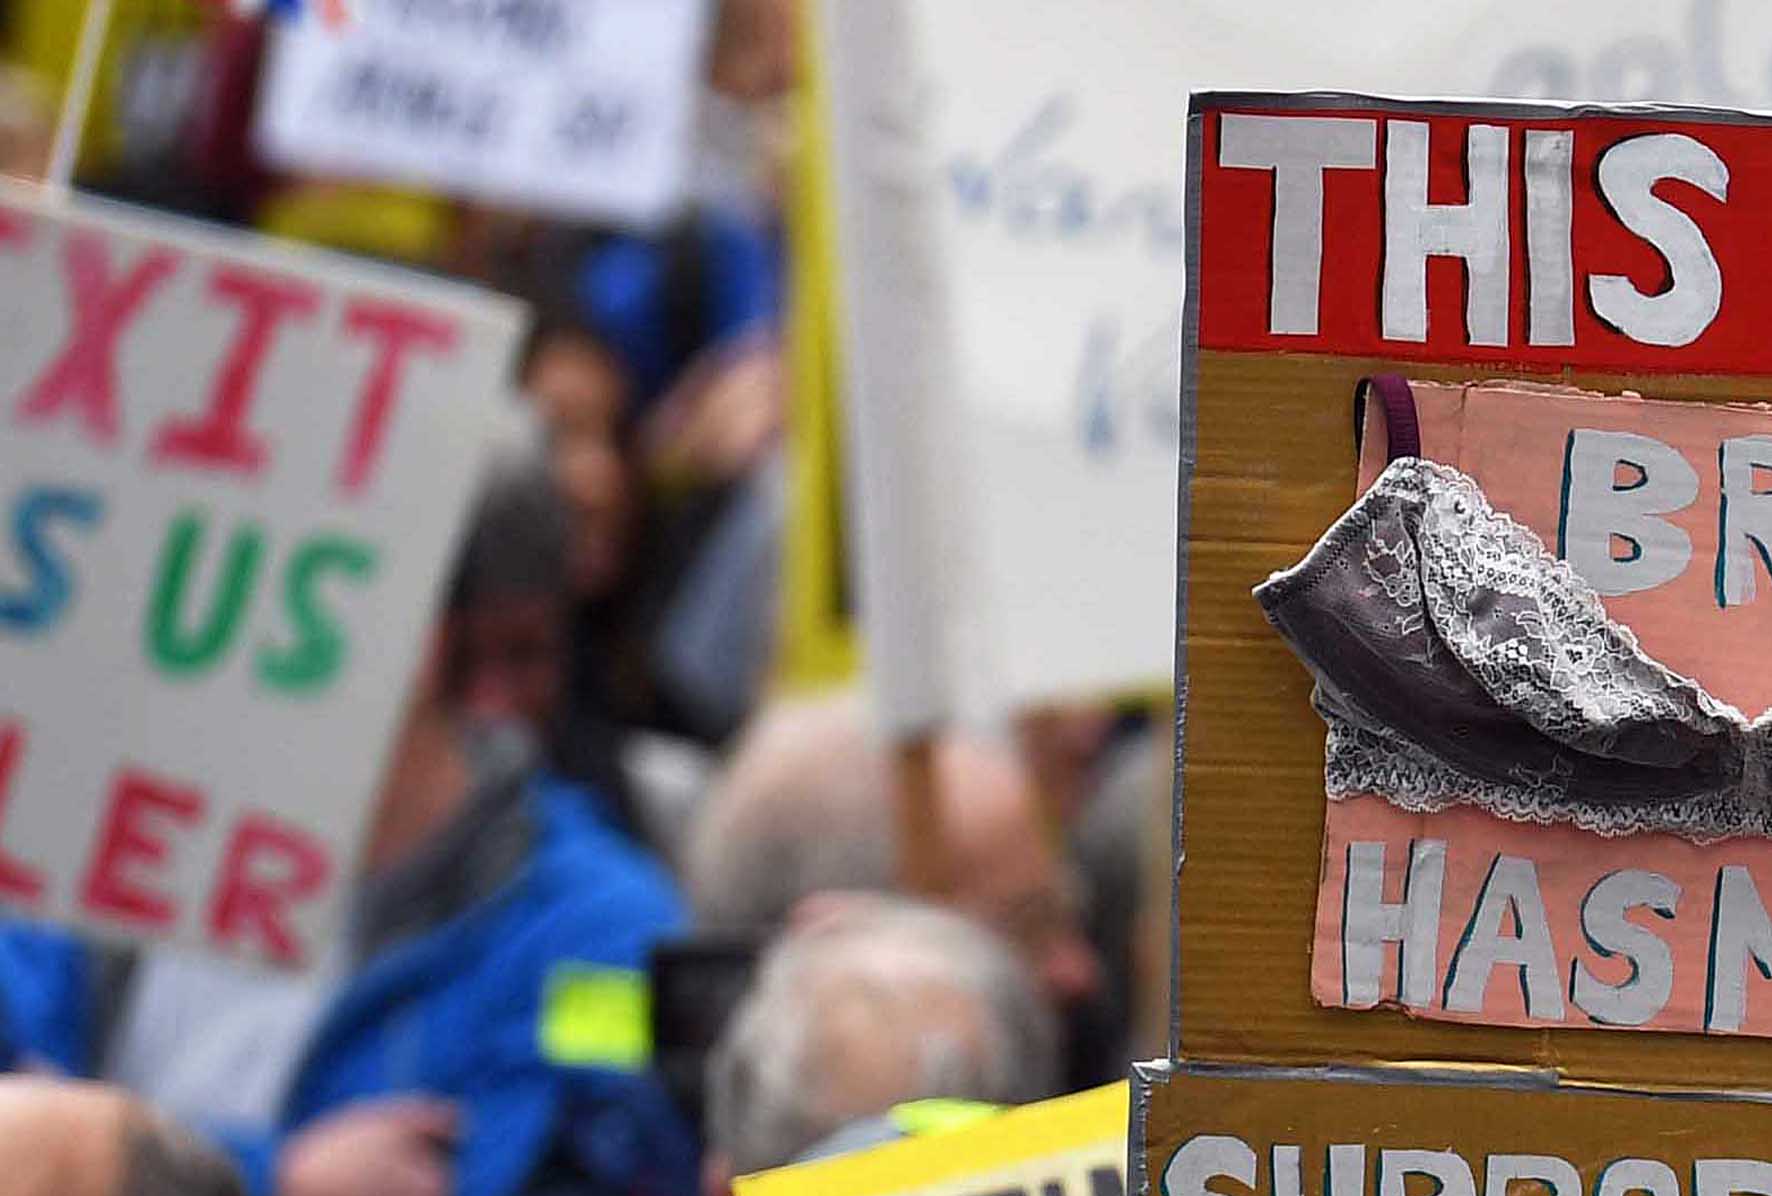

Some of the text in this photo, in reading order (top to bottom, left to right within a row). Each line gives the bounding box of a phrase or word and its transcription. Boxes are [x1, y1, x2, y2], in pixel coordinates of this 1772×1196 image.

[1218, 112, 1730, 348] THIS
[0, 205, 460, 502] XIT
[143, 508, 382, 698] US
[1342, 838, 1685, 1027] HAS
